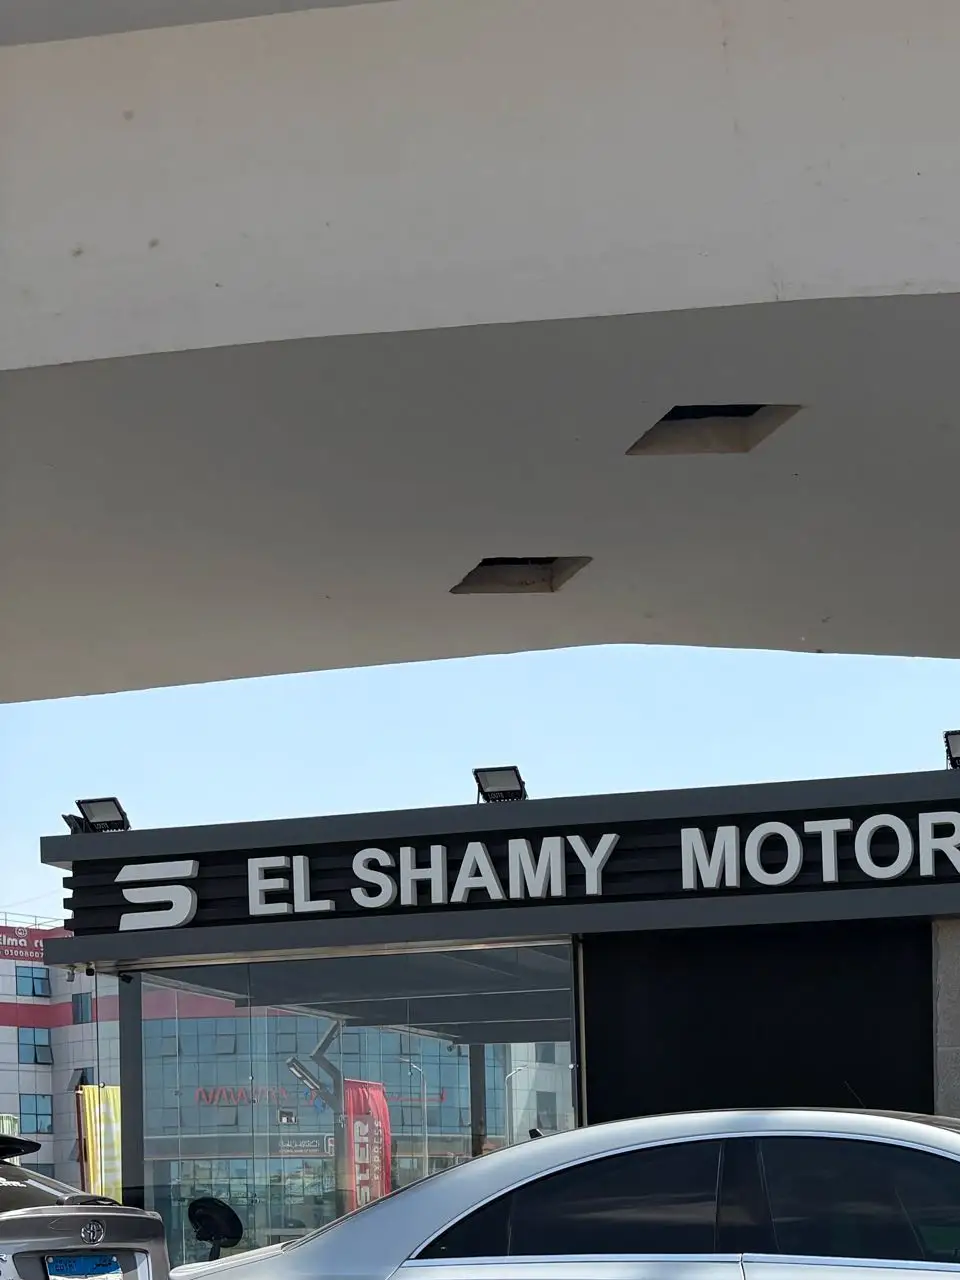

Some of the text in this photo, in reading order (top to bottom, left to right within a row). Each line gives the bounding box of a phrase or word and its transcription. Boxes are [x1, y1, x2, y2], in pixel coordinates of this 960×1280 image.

[248, 855, 335, 916] EL
[350, 833, 620, 908] SHAMY
[373, 1121, 382, 1181] EXPRESS
